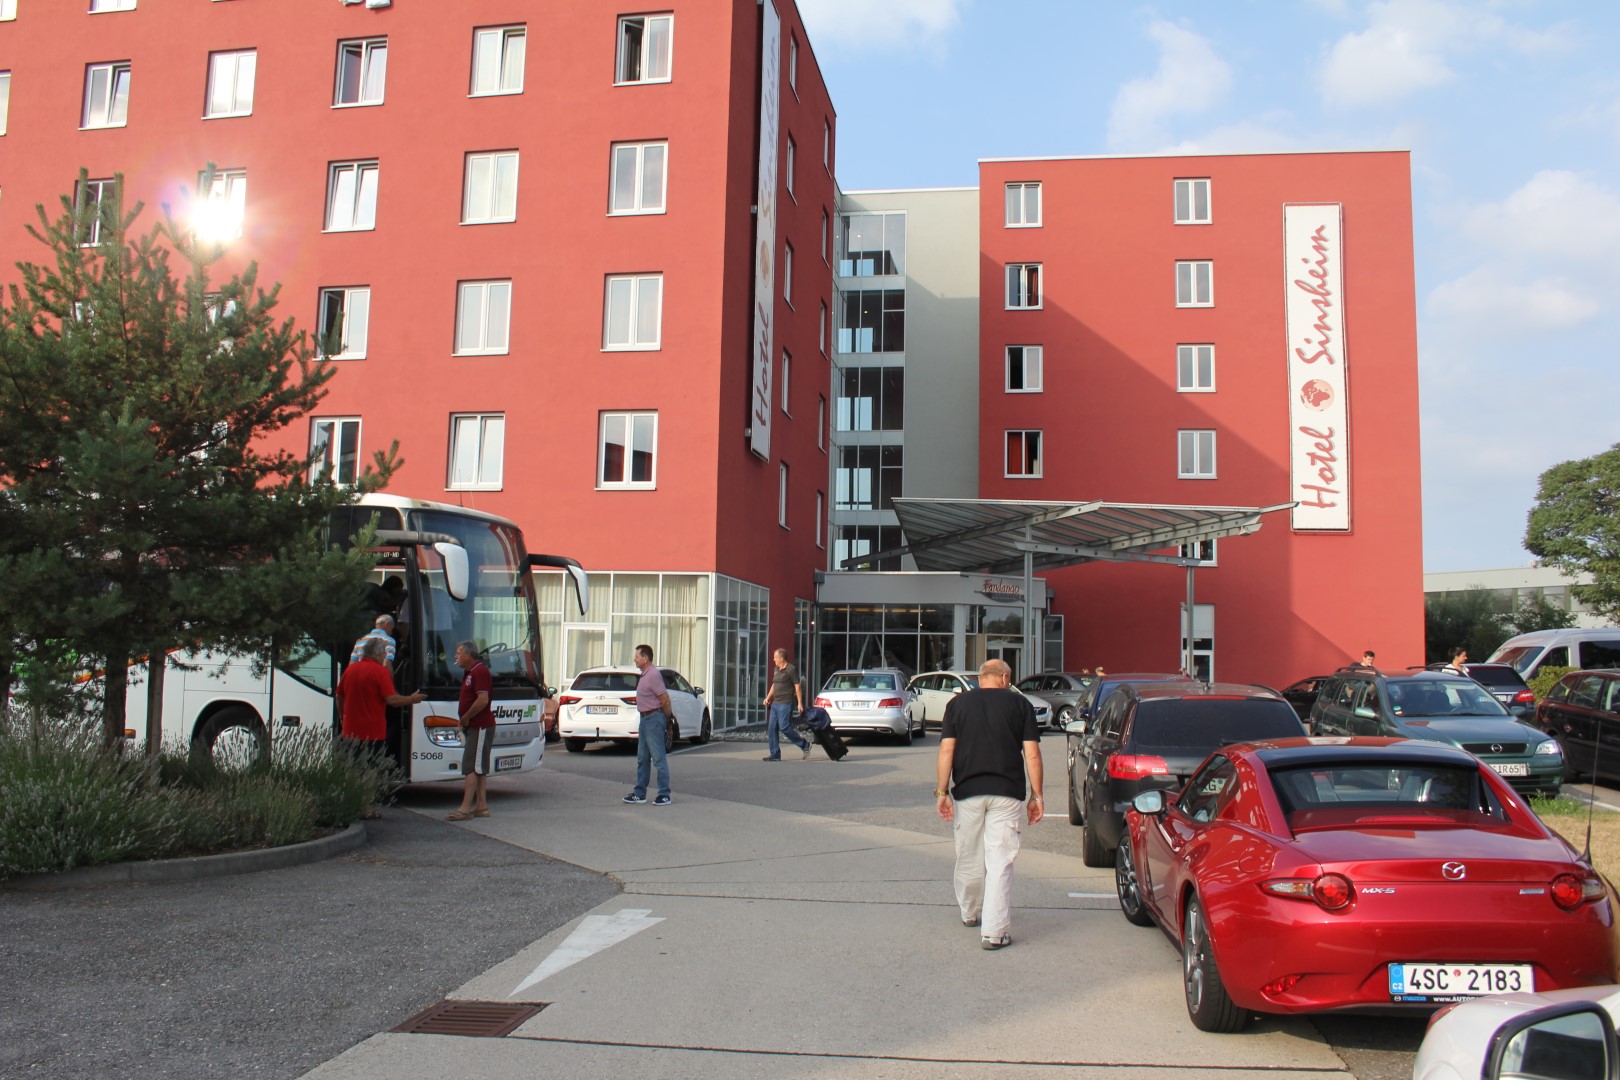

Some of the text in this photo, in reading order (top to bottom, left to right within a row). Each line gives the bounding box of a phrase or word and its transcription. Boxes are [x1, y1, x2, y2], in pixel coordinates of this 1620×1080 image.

[756, 302, 769, 427] Hotel
[1294, 224, 1340, 510] Hotel Sinsheim
[983, 579, 1020, 594] Fandango
[412, 751, 443, 760] S 5068
[1392, 983, 1403, 991] CZ
[1410, 968, 1521, 991] 4SC 2183
